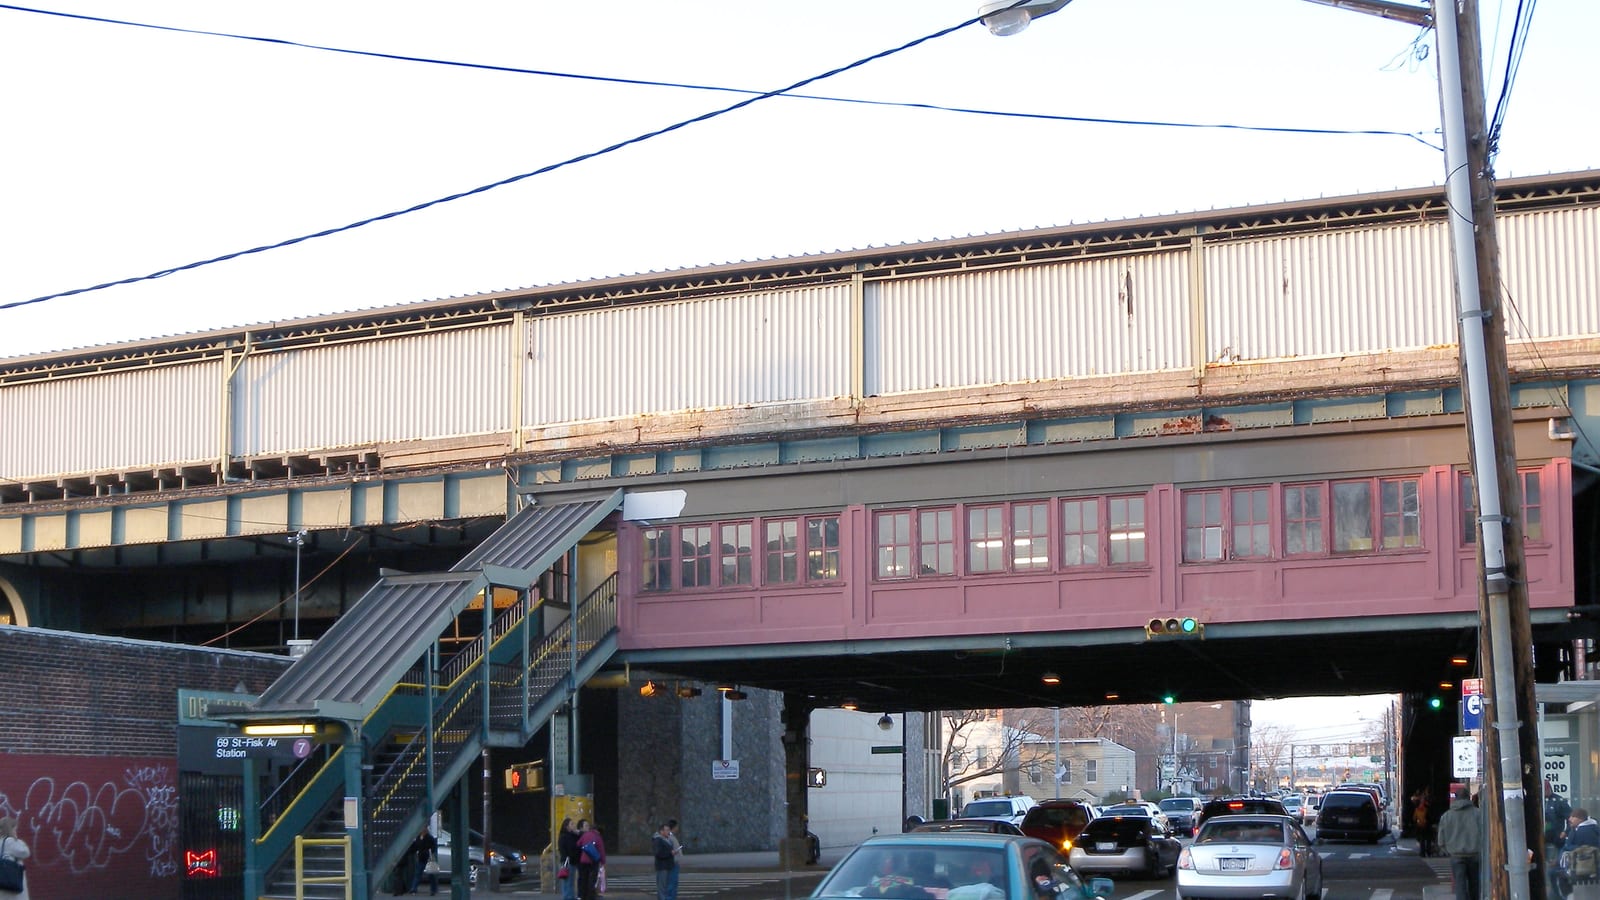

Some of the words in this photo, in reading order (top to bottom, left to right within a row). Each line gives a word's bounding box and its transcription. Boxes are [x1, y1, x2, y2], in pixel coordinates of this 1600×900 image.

[216, 738, 229, 748] 69
[231, 738, 264, 748] St-Fisk
[266, 738, 278, 747] Av
[297, 742, 306, 754] 7
[216, 748, 247, 758] Station
